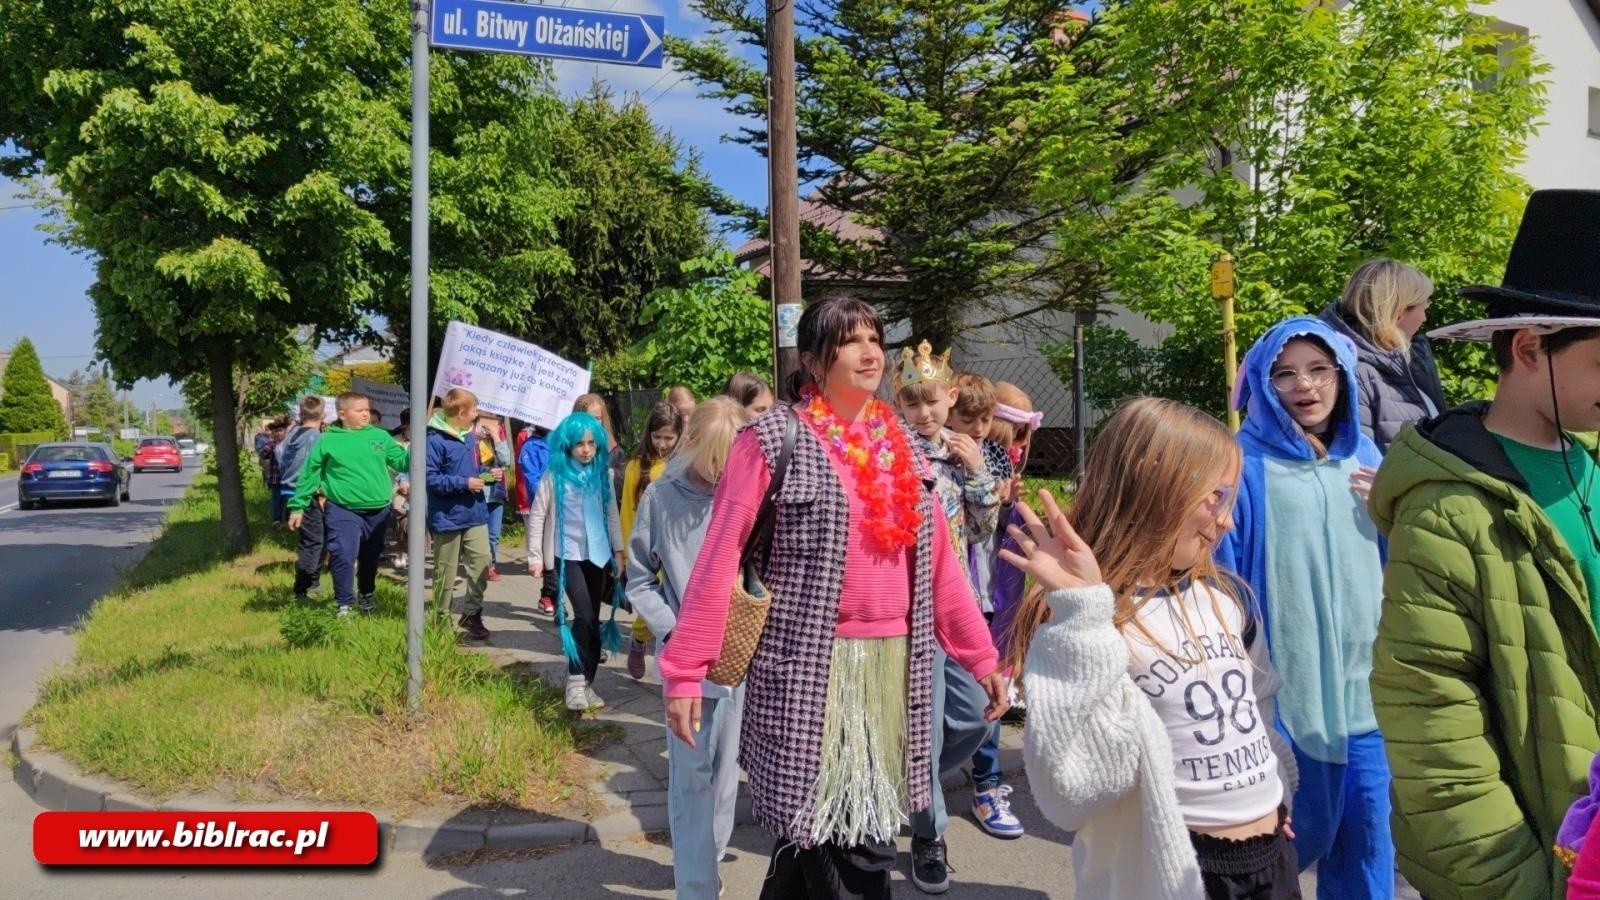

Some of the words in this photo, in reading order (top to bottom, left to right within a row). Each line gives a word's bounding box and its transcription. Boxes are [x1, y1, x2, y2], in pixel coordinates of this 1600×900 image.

[443, 8, 468, 36] ul.
[475, 9, 528, 48] Bitwy
[535, 15, 630, 58] Olżańskiej
[463, 357, 509, 377] związany
[539, 379, 567, 397] końca
[496, 339, 539, 358] człowiek
[537, 354, 577, 377] przeczyta
[476, 400, 512, 415] imberley
[1184, 669, 1257, 745] 98
[1181, 735, 1270, 782] TENNIS
[1223, 771, 1266, 792] CLUB
